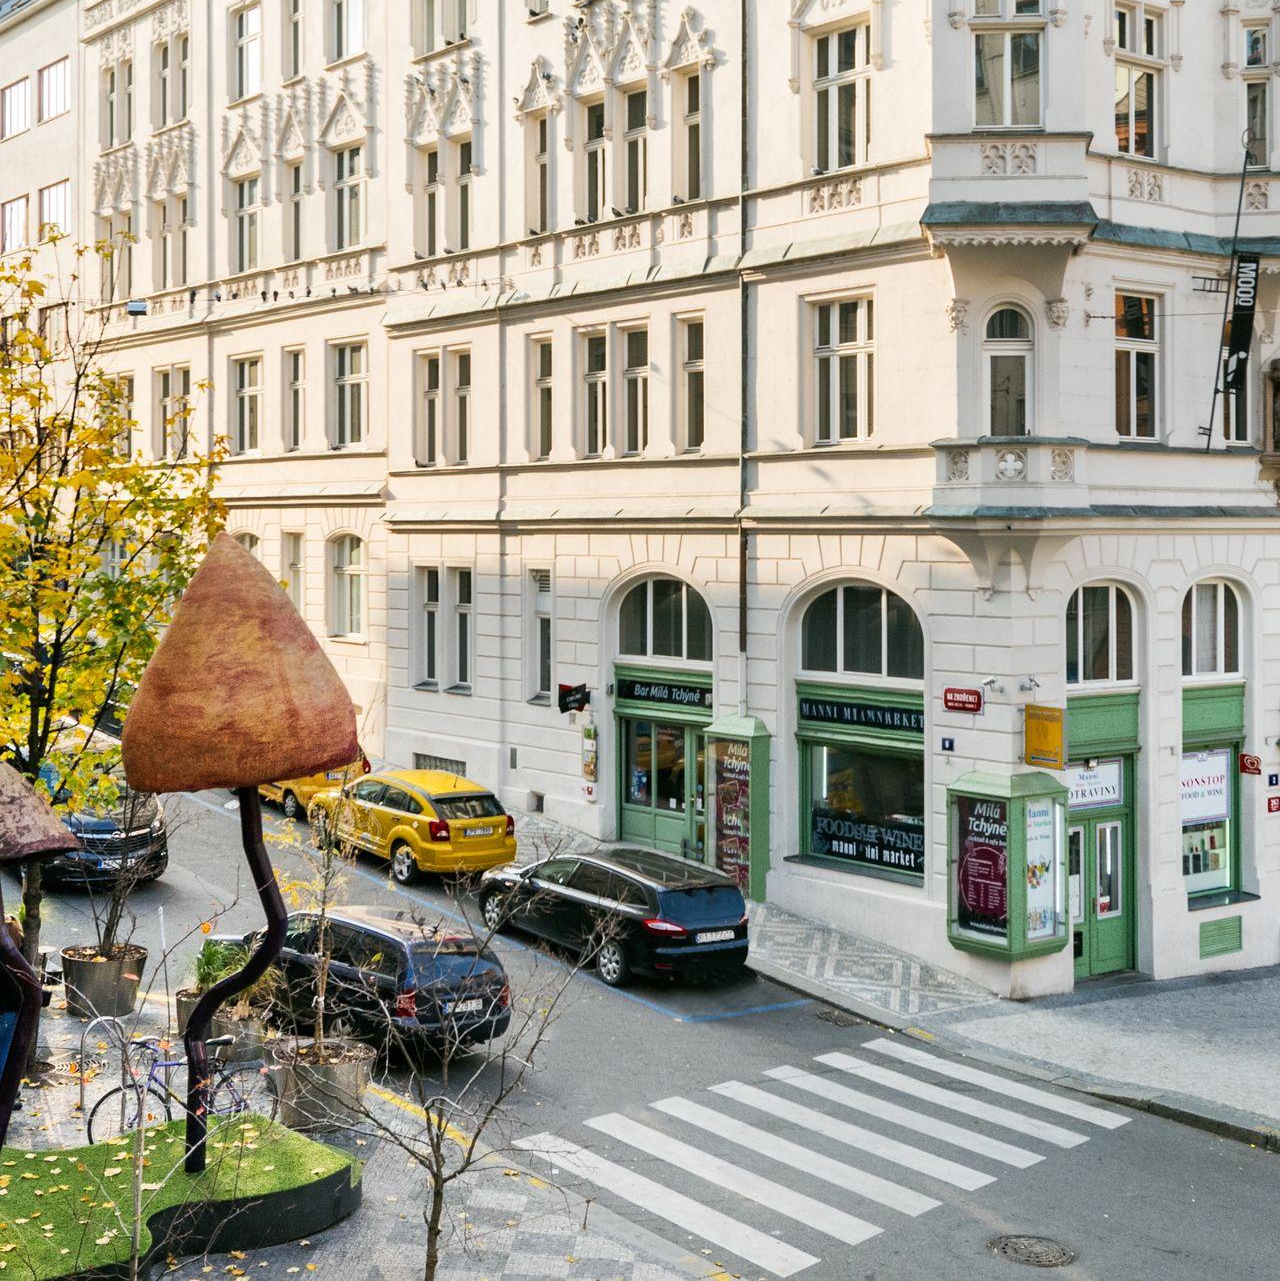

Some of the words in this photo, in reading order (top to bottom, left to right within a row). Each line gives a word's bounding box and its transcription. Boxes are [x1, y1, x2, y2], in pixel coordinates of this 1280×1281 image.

[634, 684, 649, 696] Bar
[650, 686, 669, 698] Milá
[672, 688, 701, 703] Tchýně
[802, 702, 837, 719] MANNI
[974, 802, 1001, 819] Milá
[968, 817, 1007, 835] Tchýně
[832, 840, 857, 856] manni
[883, 849, 915, 868] market
